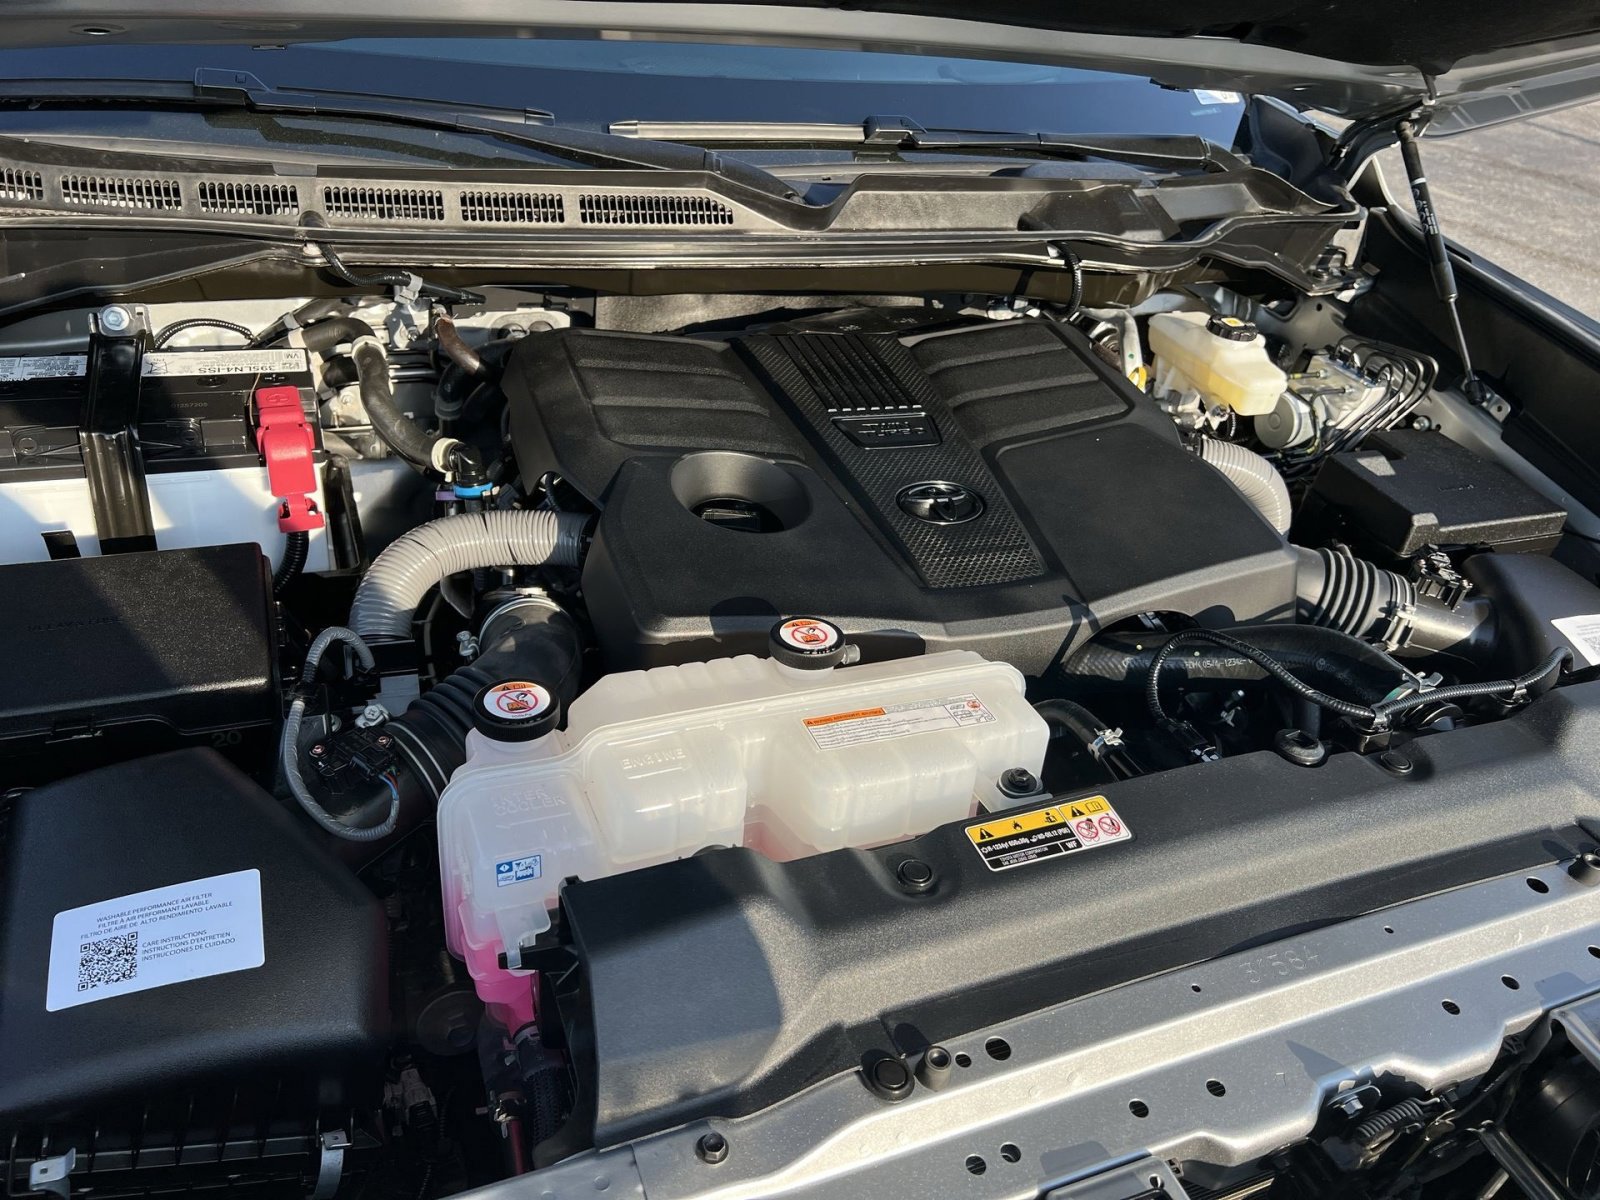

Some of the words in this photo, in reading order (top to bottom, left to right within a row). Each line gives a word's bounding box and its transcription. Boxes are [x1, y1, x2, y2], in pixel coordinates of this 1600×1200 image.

[622, 747, 687, 770] ENGINE
[1066, 841, 1077, 849] WF
[97, 909, 131, 923] WASHABLE
[132, 899, 179, 915] PERFORMANCE
[192, 892, 212, 901] FILTER
[98, 920, 118, 929] FILTRE
[126, 915, 136, 923] AIR
[137, 906, 180, 920] PERFORMANT
[181, 900, 209, 910] LAVABLE
[80, 930, 103, 940] FILTRO
[114, 924, 128, 932] AIRE
[140, 917, 157, 926] ALTO
[159, 907, 203, 921] RENDIMIENTO
[205, 901, 233, 911] LAVABLE
[142, 939, 159, 947] CARE
[160, 929, 207, 944] INSTRUCTIONS
[142, 939, 188, 954] INSTRUCTIONS
[190, 931, 231, 943] D'ENTRETIEN
[142, 947, 194, 961] INSTRUCCIONES
[205, 937, 236, 949] CUIDADO
